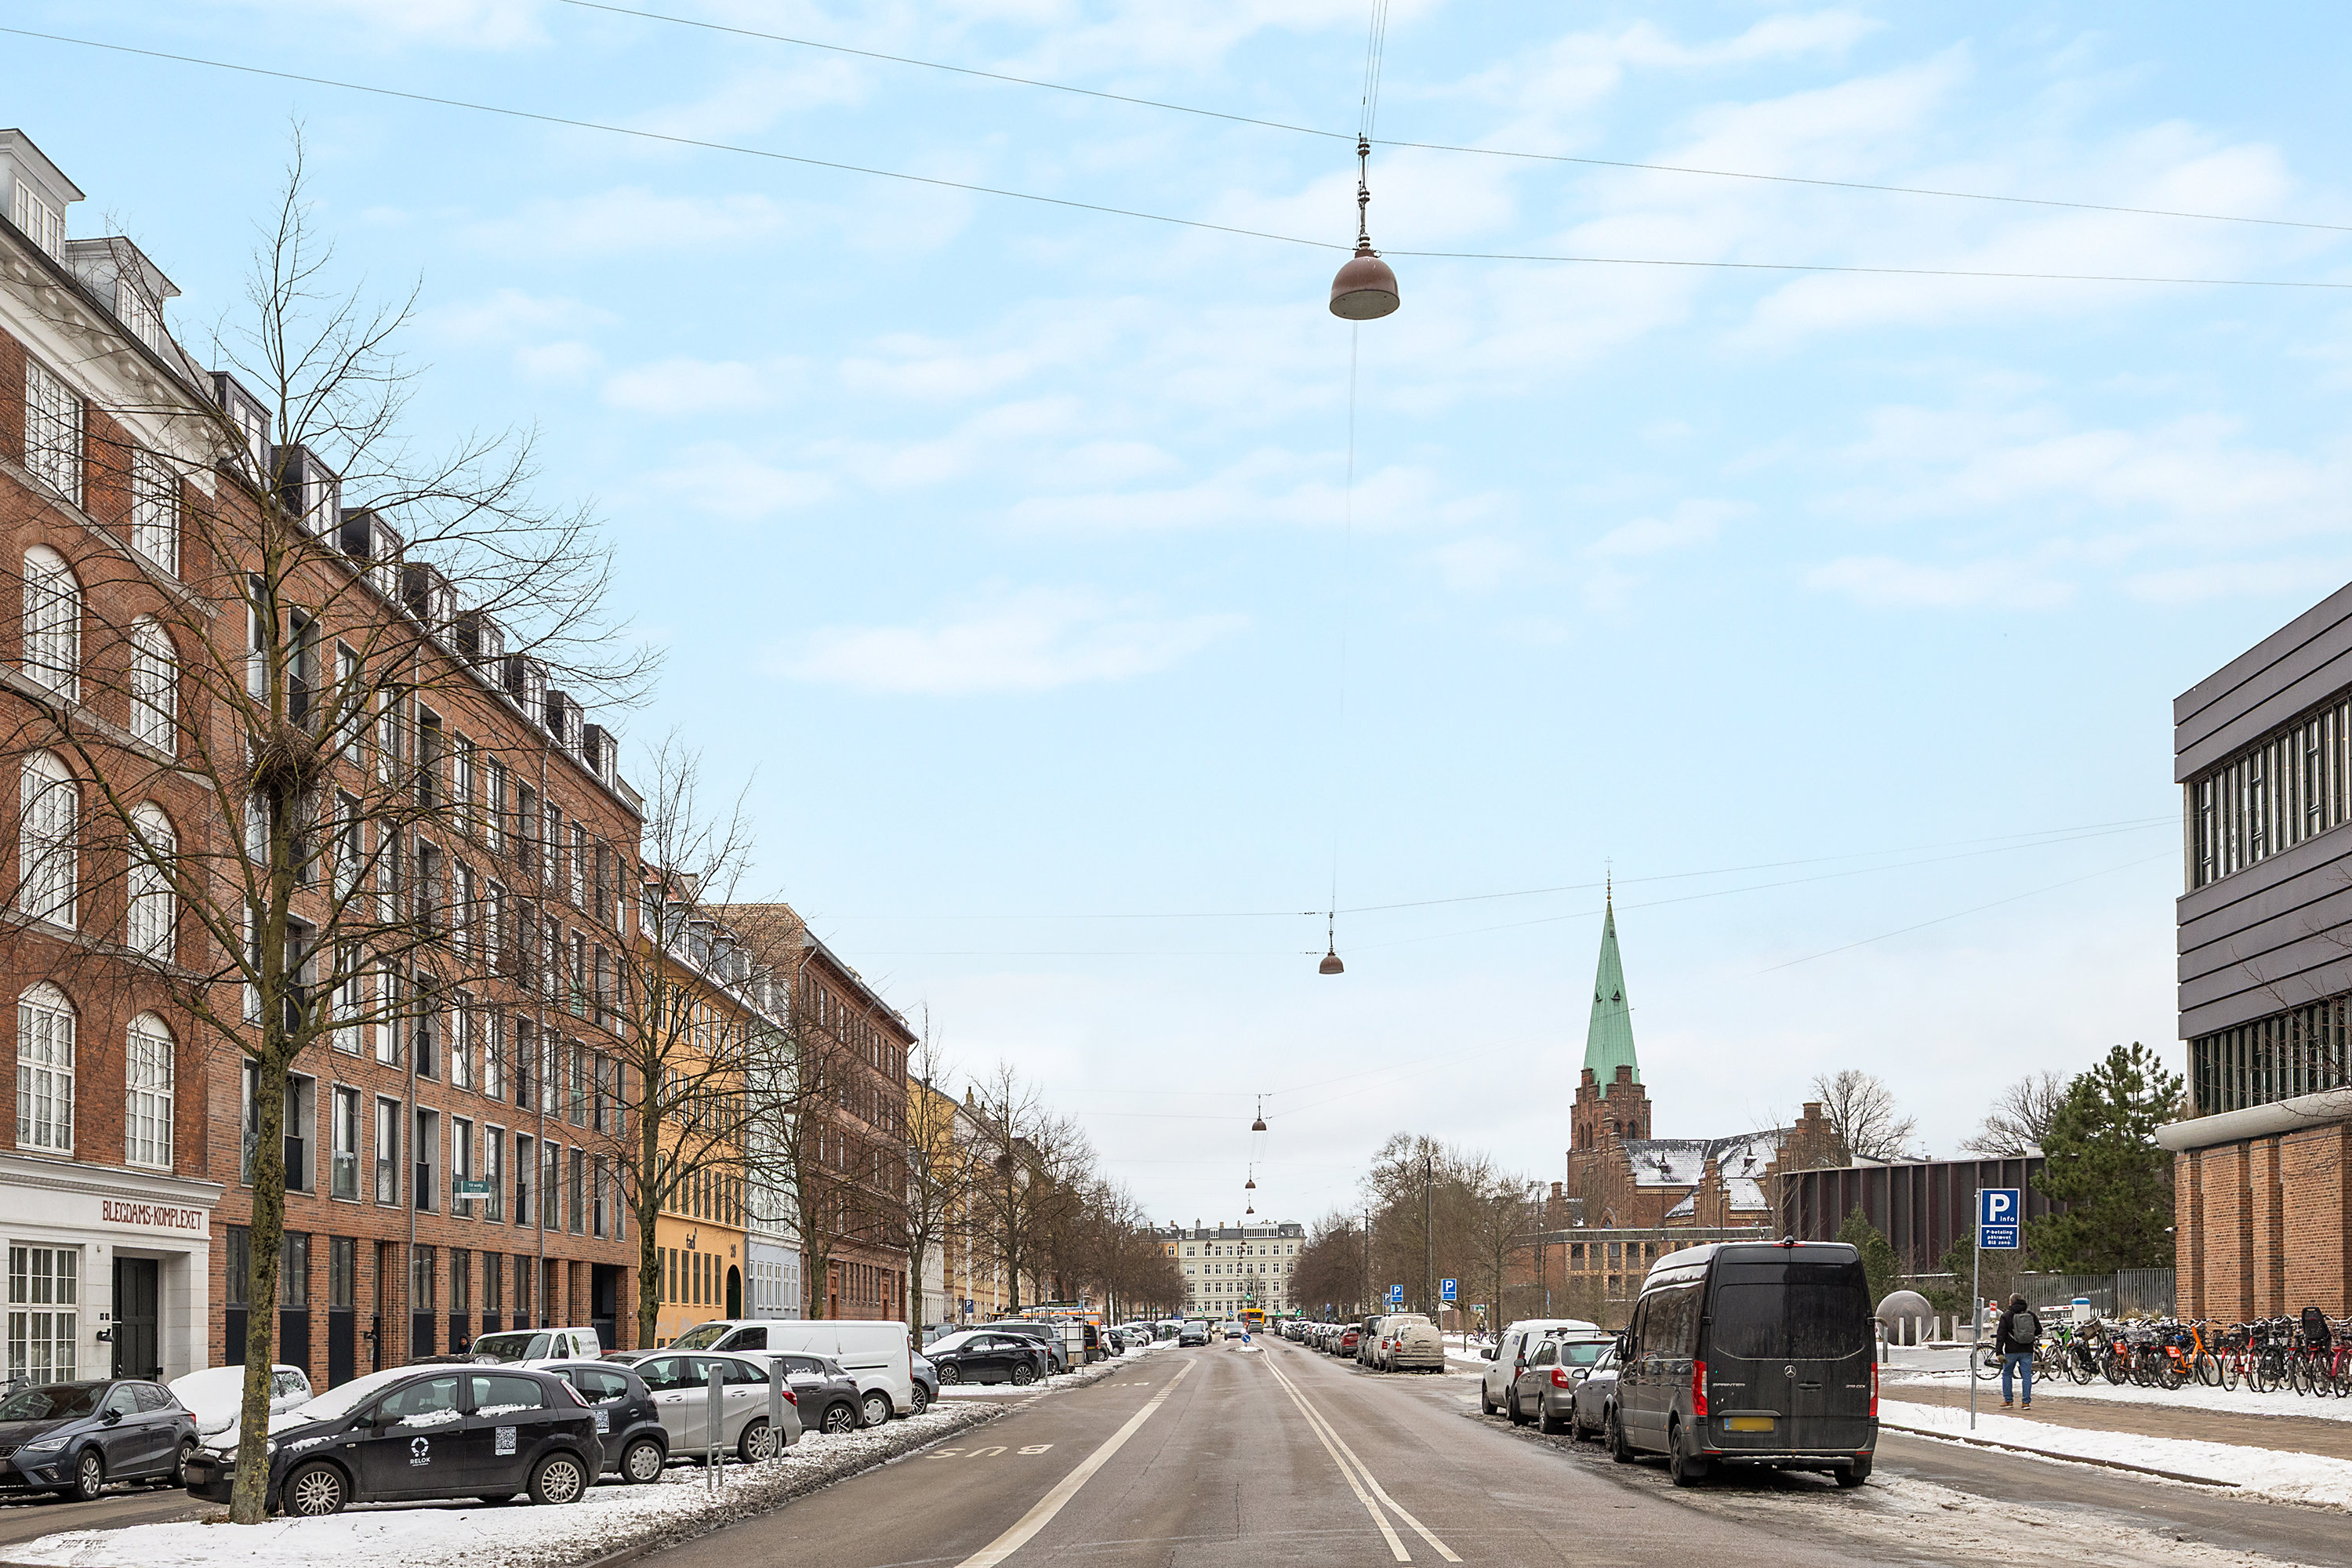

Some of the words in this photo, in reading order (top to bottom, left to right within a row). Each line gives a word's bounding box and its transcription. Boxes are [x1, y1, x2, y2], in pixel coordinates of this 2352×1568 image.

[1989, 1193, 2010, 1222] P
[1446, 1280, 1454, 1291] P
[925, 1443, 1054, 1459] BUS
